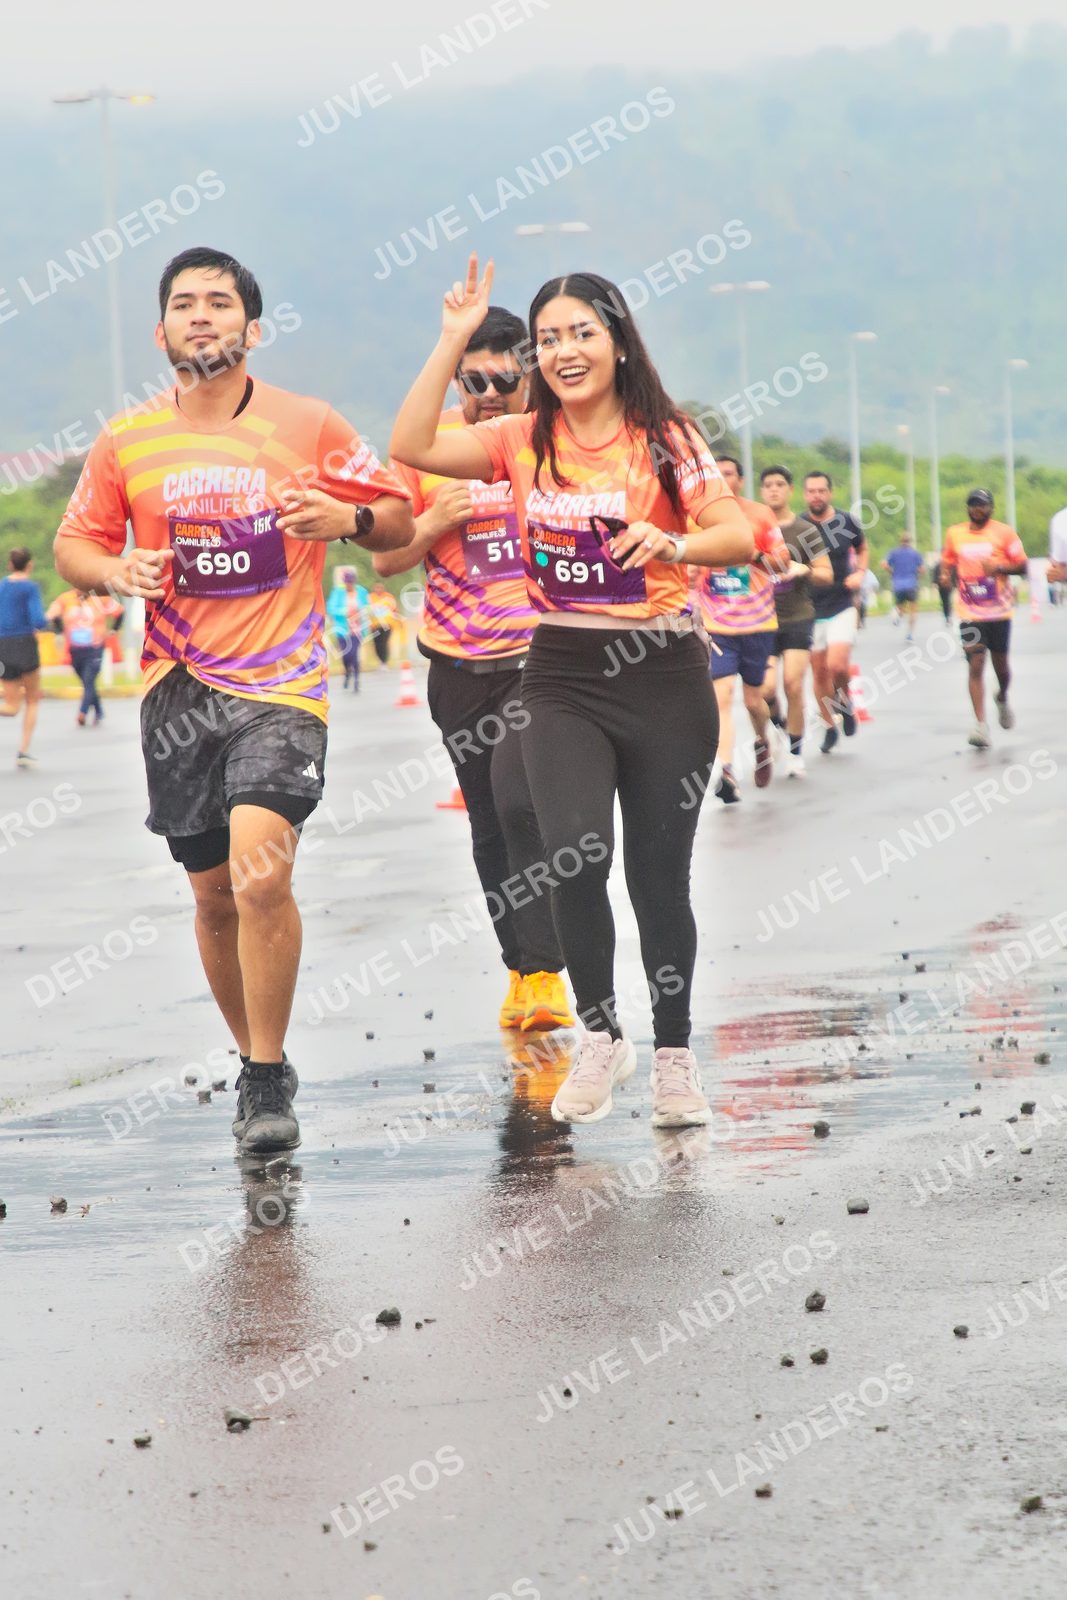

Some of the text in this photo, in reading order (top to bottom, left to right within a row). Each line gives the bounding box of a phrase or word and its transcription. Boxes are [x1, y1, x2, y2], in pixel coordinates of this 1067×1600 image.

[163, 465, 266, 502] CARRERA
[526, 488, 626, 517] CARRERA
[175, 523, 221, 538] CARRERA
[466, 519, 506, 534] CARRERA
[533, 528, 576, 547] CARRERA
[487, 538, 523, 562] 51
[197, 550, 251, 576] 690
[555, 559, 605, 584] 691
